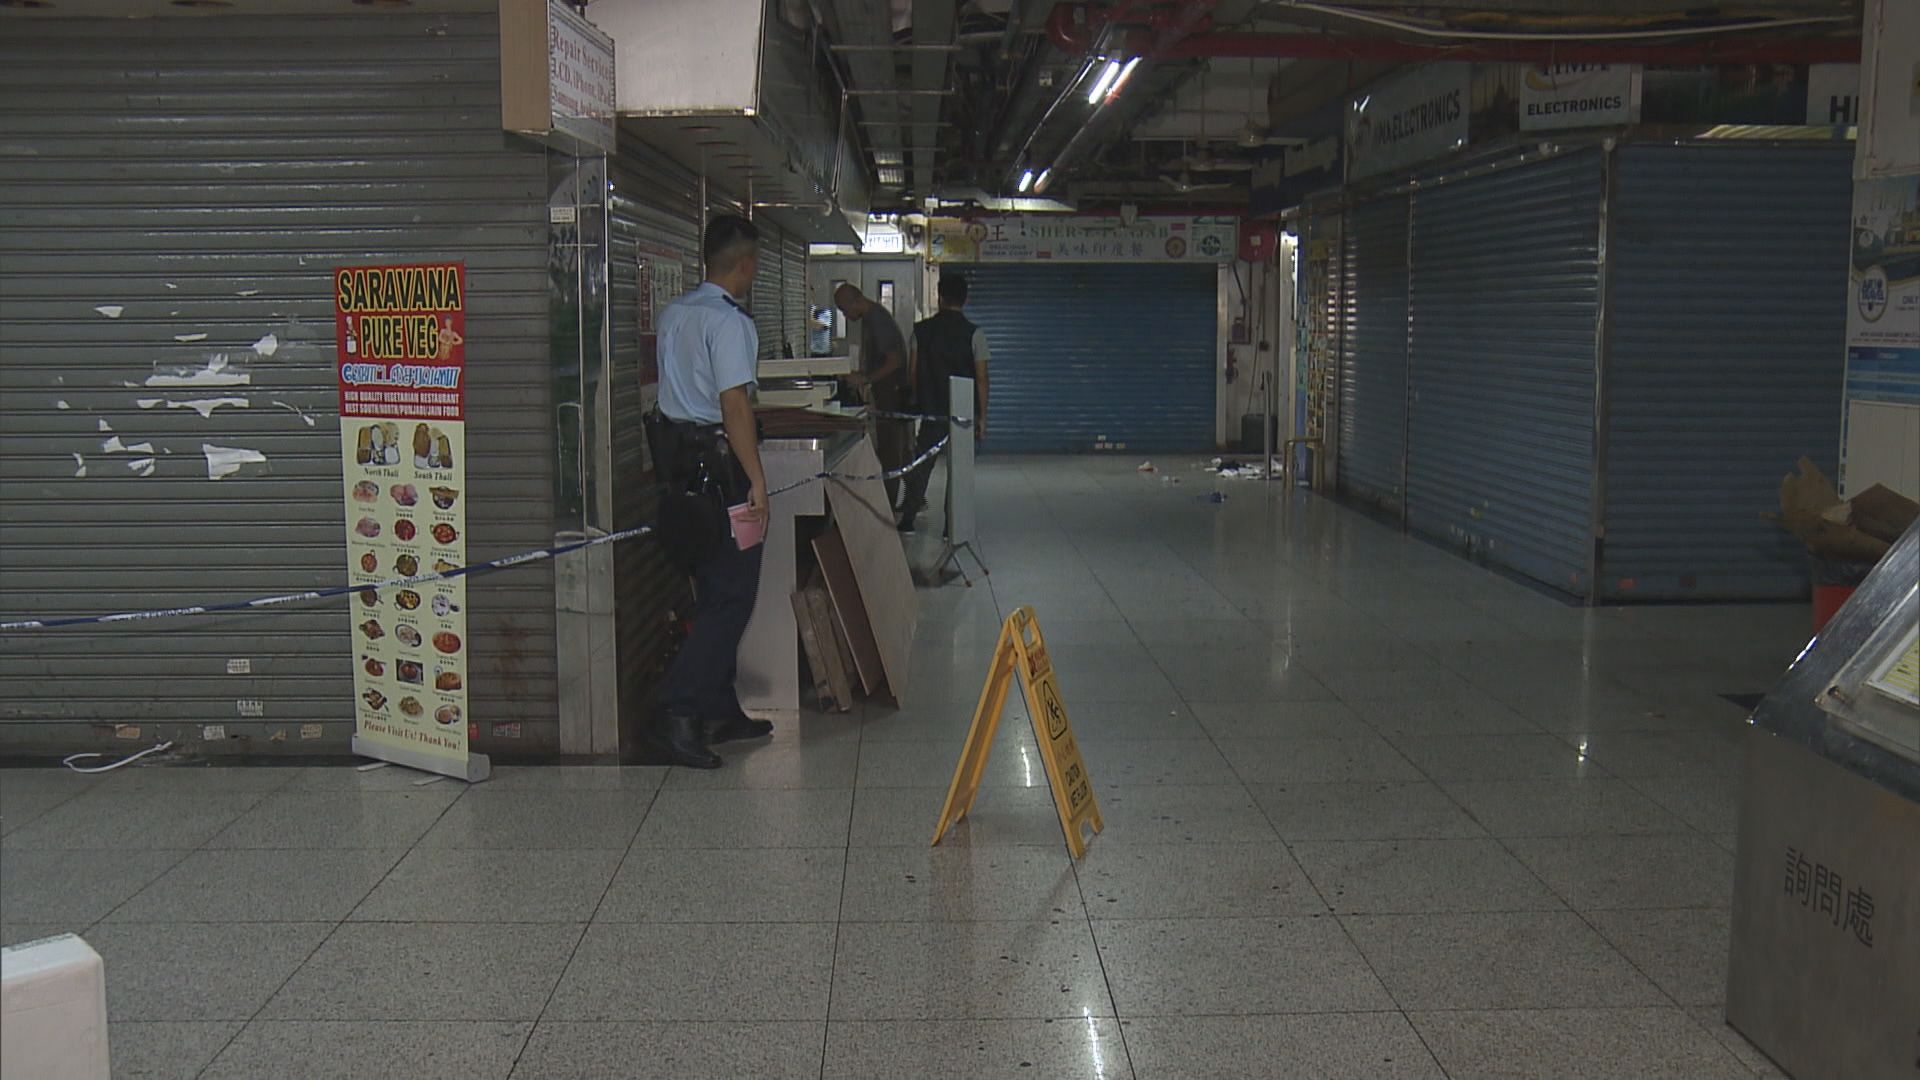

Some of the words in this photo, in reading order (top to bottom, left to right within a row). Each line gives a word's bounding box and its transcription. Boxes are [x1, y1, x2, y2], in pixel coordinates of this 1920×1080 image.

[1527, 95, 1622, 116] ELECTRONICS
[338, 266, 462, 313] SARAVANA
[360, 315, 404, 359] PURE
[404, 314, 439, 359] VEG
[364, 467, 382, 477] North
[383, 468, 399, 478] Thali
[414, 470, 433, 480] South
[435, 471, 453, 481] Thali
[364, 719, 387, 734] Please
[387, 724, 403, 737] Visit
[404, 729, 418, 740] Us!
[419, 732, 442, 746] Thank
[443, 738, 461, 751] You!
[1783, 846, 1875, 950] 詢問處
